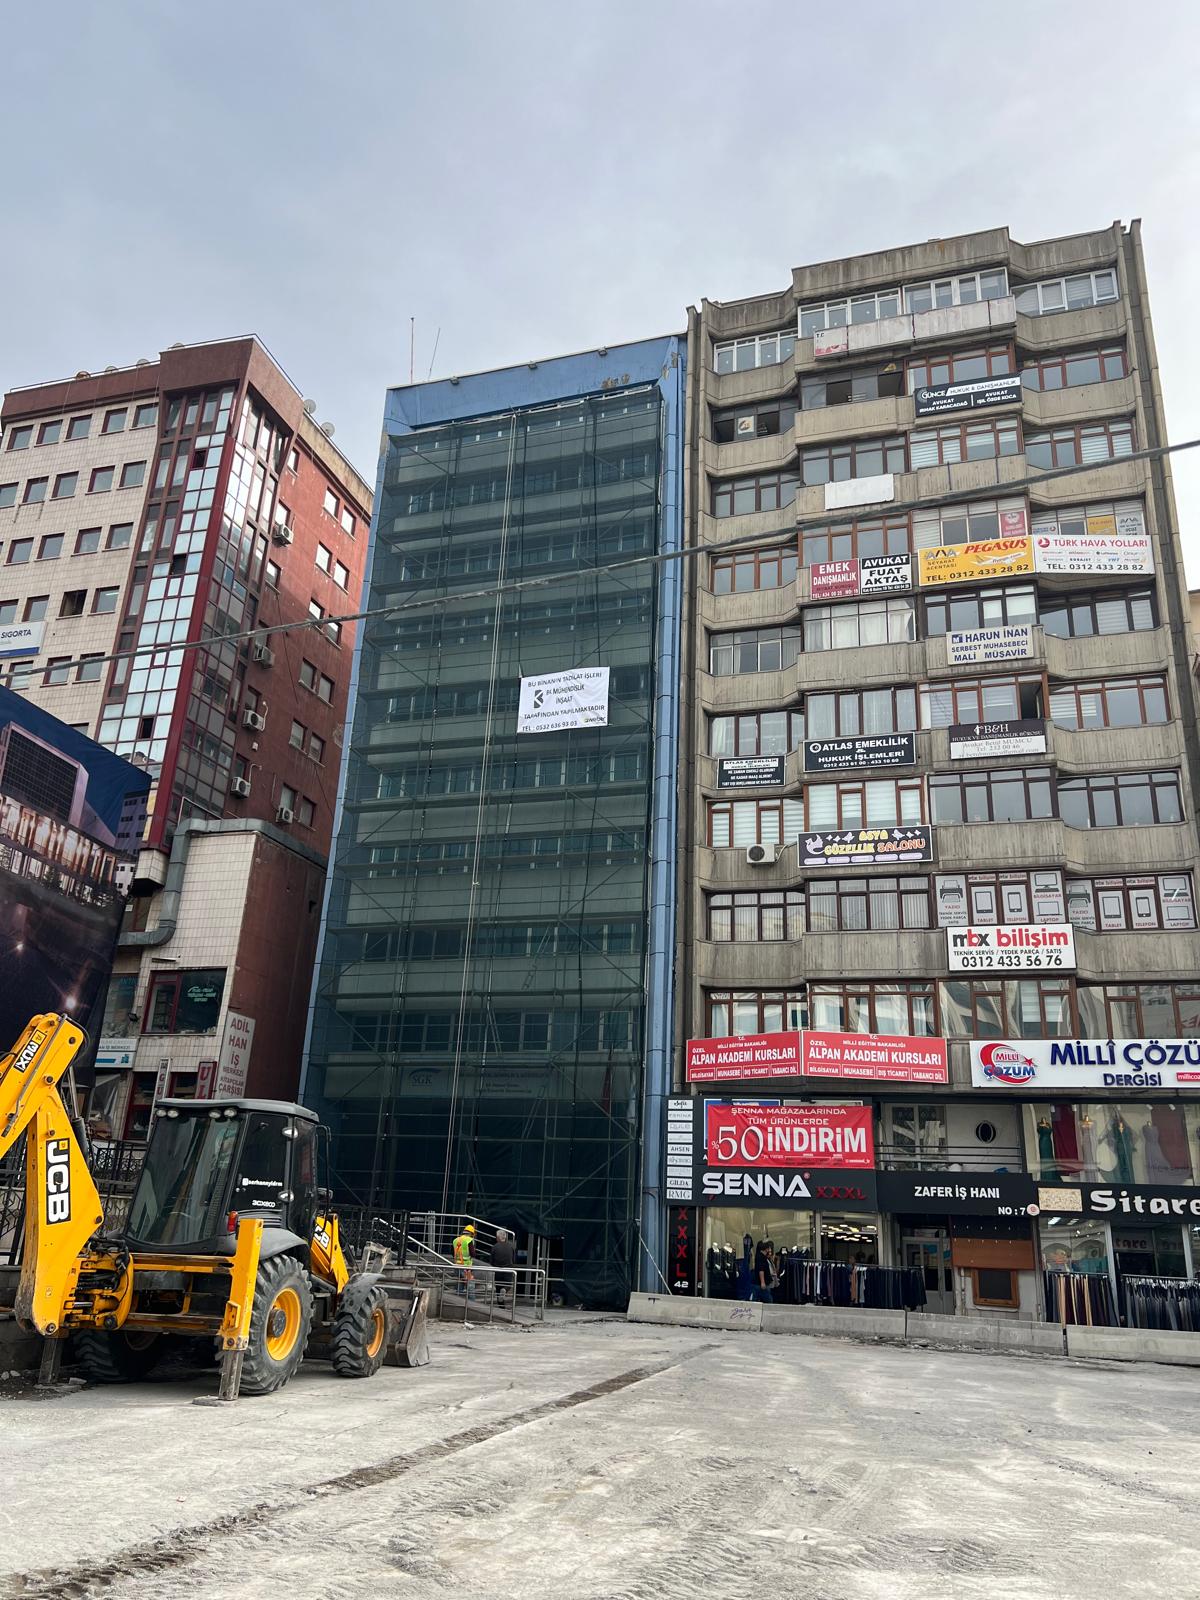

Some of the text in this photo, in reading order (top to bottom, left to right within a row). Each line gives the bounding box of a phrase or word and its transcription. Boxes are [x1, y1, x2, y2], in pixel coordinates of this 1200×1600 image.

[932, 398, 955, 406] AVUKAT
[964, 538, 1028, 554] PEGASUS
[1054, 537, 1148, 547] TÜRK HAVA YOLLARI
[819, 561, 850, 575] EMEK
[864, 555, 908, 568] AVUKAT
[869, 566, 902, 577] FUAT
[926, 574, 946, 582] TEL:
[950, 570, 975, 579] 0312
[978, 568, 997, 576] 433
[813, 571, 857, 586] DANIŞMANLIK
[864, 574, 908, 586] AKTAŞ
[965, 627, 1028, 643] HARUN İNAN
[951, 639, 1028, 653] SERBEST MUHASEBECİ
[954, 652, 977, 662] MALİ
[524, 711, 560, 720] TARAFINDAN
[983, 723, 1009, 734] B&H
[822, 737, 909, 752] ATLAS EMEKLİLİK
[818, 750, 905, 763] HUKUK İŞLEMLERİ
[858, 829, 889, 841] ASYA
[824, 838, 926, 856] GÜZELLİK SALONU
[952, 927, 1069, 949] mbx bilişim
[975, 948, 994, 956] SERVİS
[962, 955, 1063, 968] 0312 433 56 76
[230, 1017, 250, 1033] ADİL
[229, 1035, 248, 1050] HAN
[810, 1039, 827, 1047] ÖZEL
[230, 1053, 240, 1068] İŞ
[691, 1047, 796, 1066] ALPAN AKADEMİ KURSLARI
[809, 1047, 941, 1066] ALPAN AKADEMİ KURSLARI
[717, 1069, 741, 1077] MUHASEBE
[772, 1067, 789, 1075] YABANCI
[809, 1066, 943, 1080] BİLGİSAYAR MUHASEBE DIŞ TİCARET YABANCI DİL
[1103, 1071, 1162, 1086] DERGİSİ
[218, 1083, 243, 1096] ÇARŞISI
[731, 1106, 847, 1116] ŞENNA MAĞAZALARINDA
[747, 1116, 829, 1126] TÜM ÜRÜNLERDE
[47, 1141, 70, 1223] JCB
[914, 1184, 1000, 1200] ZAFER İŞ HANI
[998, 1206, 1026, 1215] NO 7
[674, 1280, 689, 1288] 42
